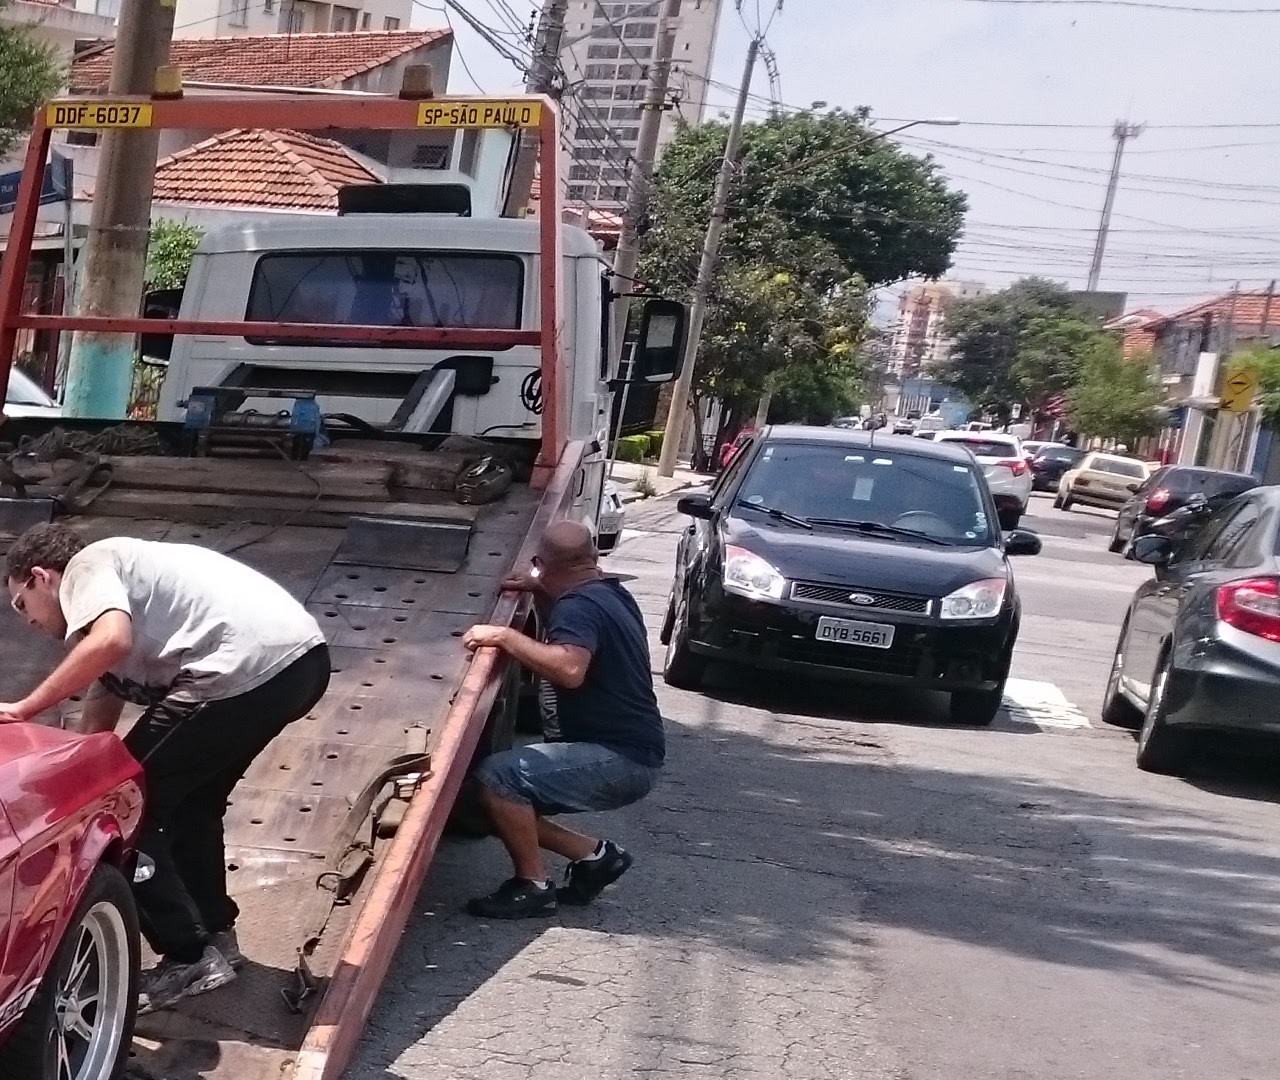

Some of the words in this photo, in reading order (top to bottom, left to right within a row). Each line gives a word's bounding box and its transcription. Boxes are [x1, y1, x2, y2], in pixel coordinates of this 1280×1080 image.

[55, 107, 141, 124] DDF-6037
[424, 104, 477, 125] SP-SÃO
[483, 107, 531, 124] PAULO
